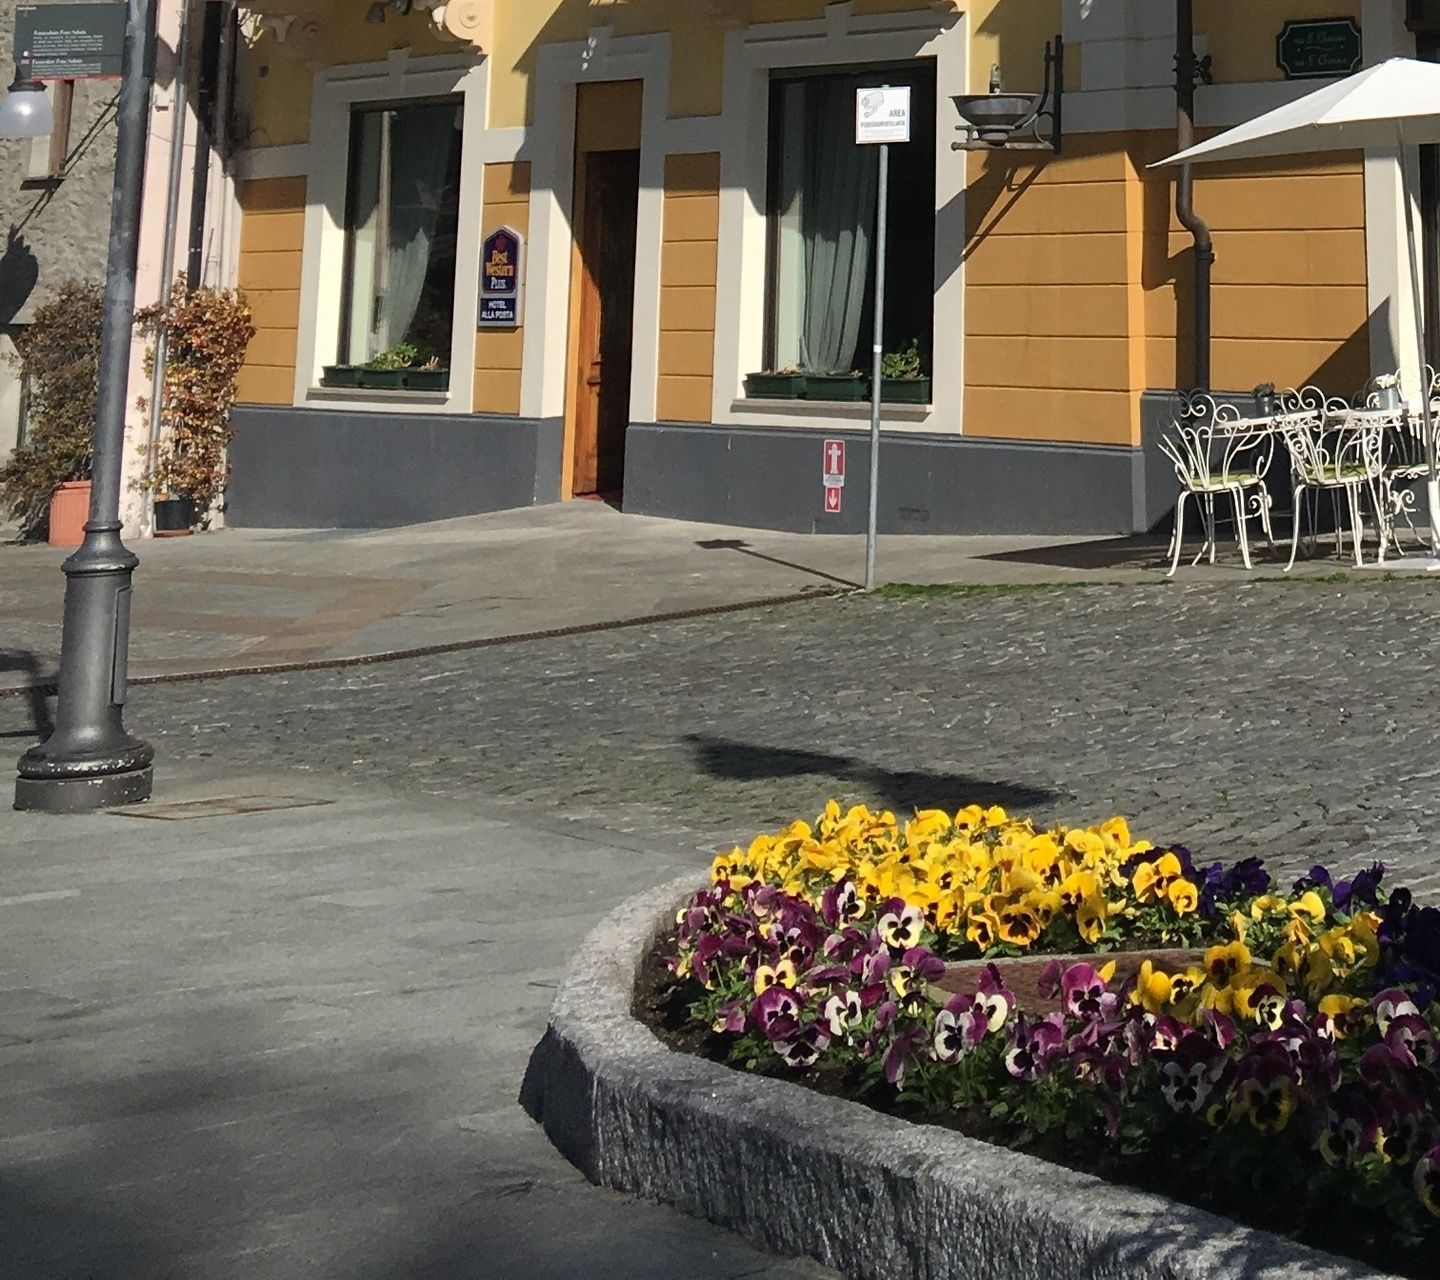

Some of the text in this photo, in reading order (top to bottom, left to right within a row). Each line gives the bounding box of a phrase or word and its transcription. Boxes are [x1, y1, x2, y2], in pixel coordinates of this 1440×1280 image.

[888, 109, 906, 118] AREA
[492, 250, 508, 264] Best
[486, 262, 513, 276] Western
[488, 301, 507, 309] HOTEL
[482, 310, 513, 319] ALLA POSTA
